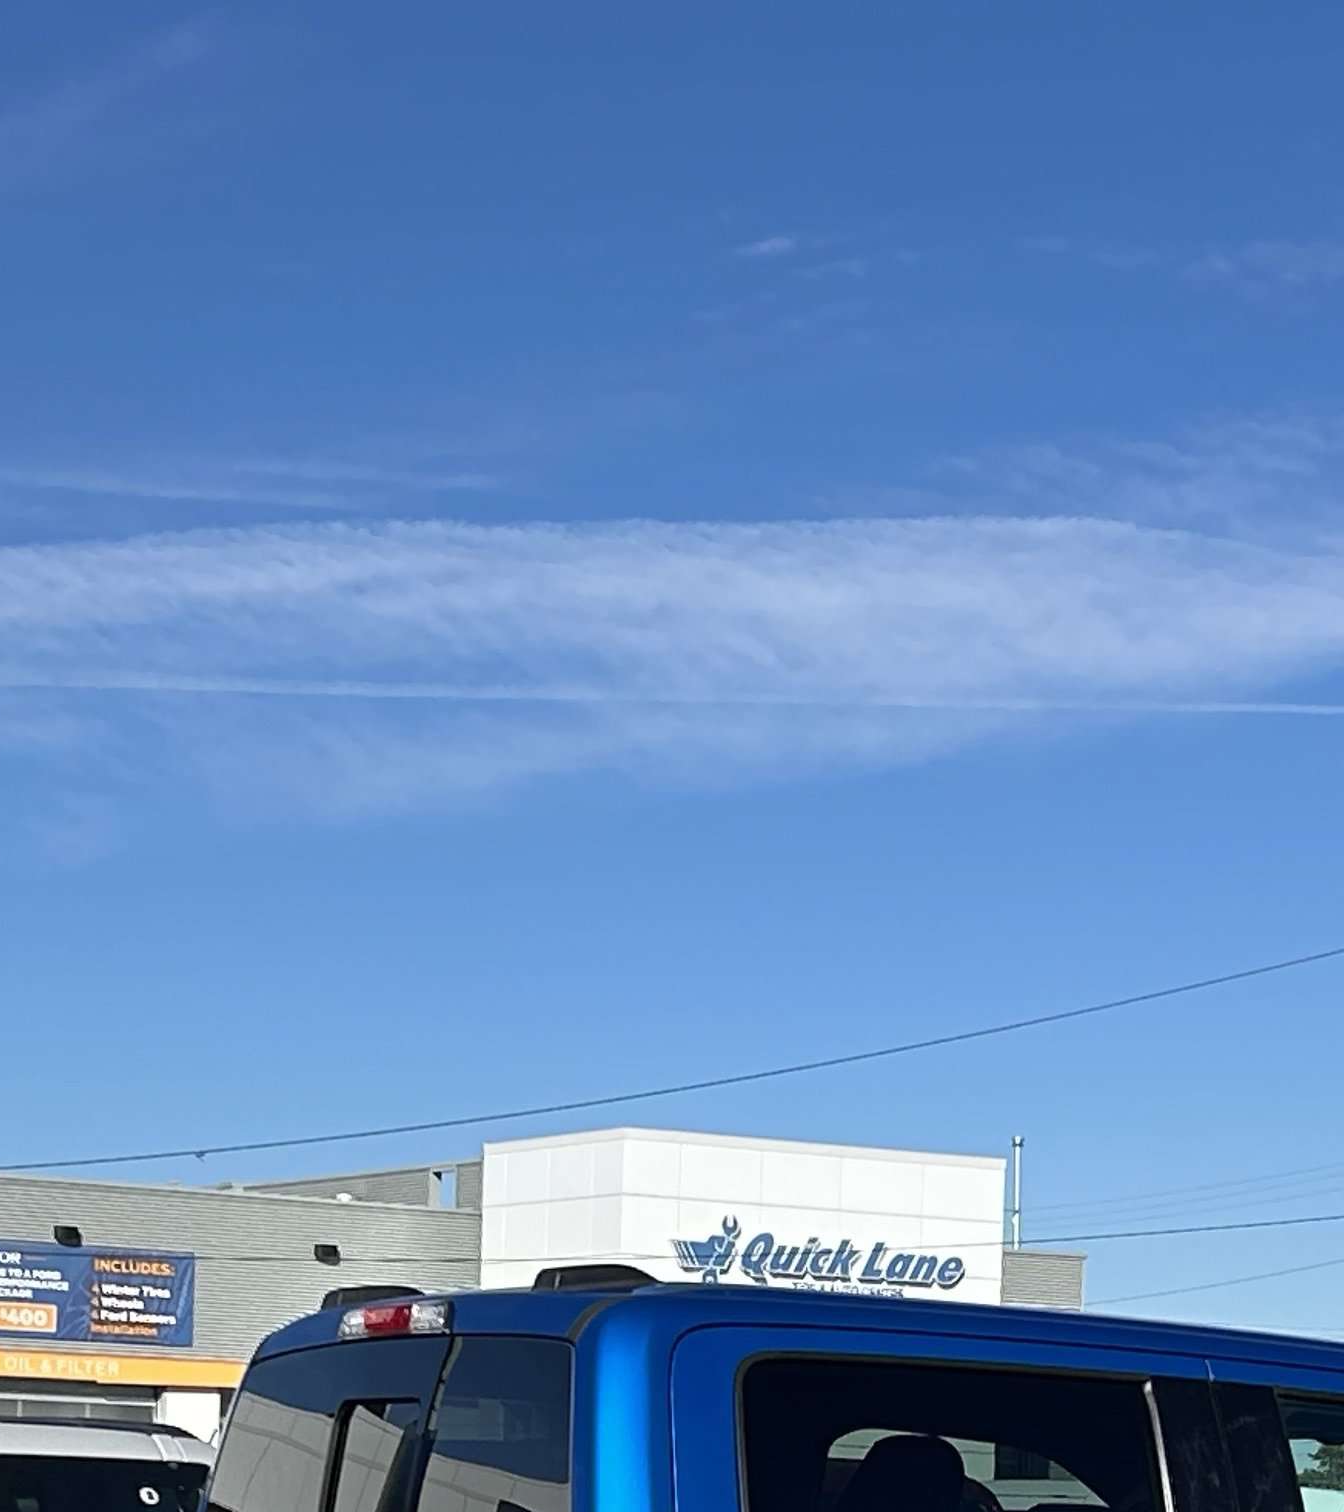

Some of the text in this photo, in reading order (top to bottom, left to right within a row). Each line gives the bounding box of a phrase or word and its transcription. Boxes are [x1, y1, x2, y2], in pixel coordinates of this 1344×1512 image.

[93, 1259, 175, 1276] INCLUDES:
[739, 1232, 965, 1289] Quick Lane
[3, 1356, 32, 1372] OIL
[55, 1359, 120, 1377] FILTER
